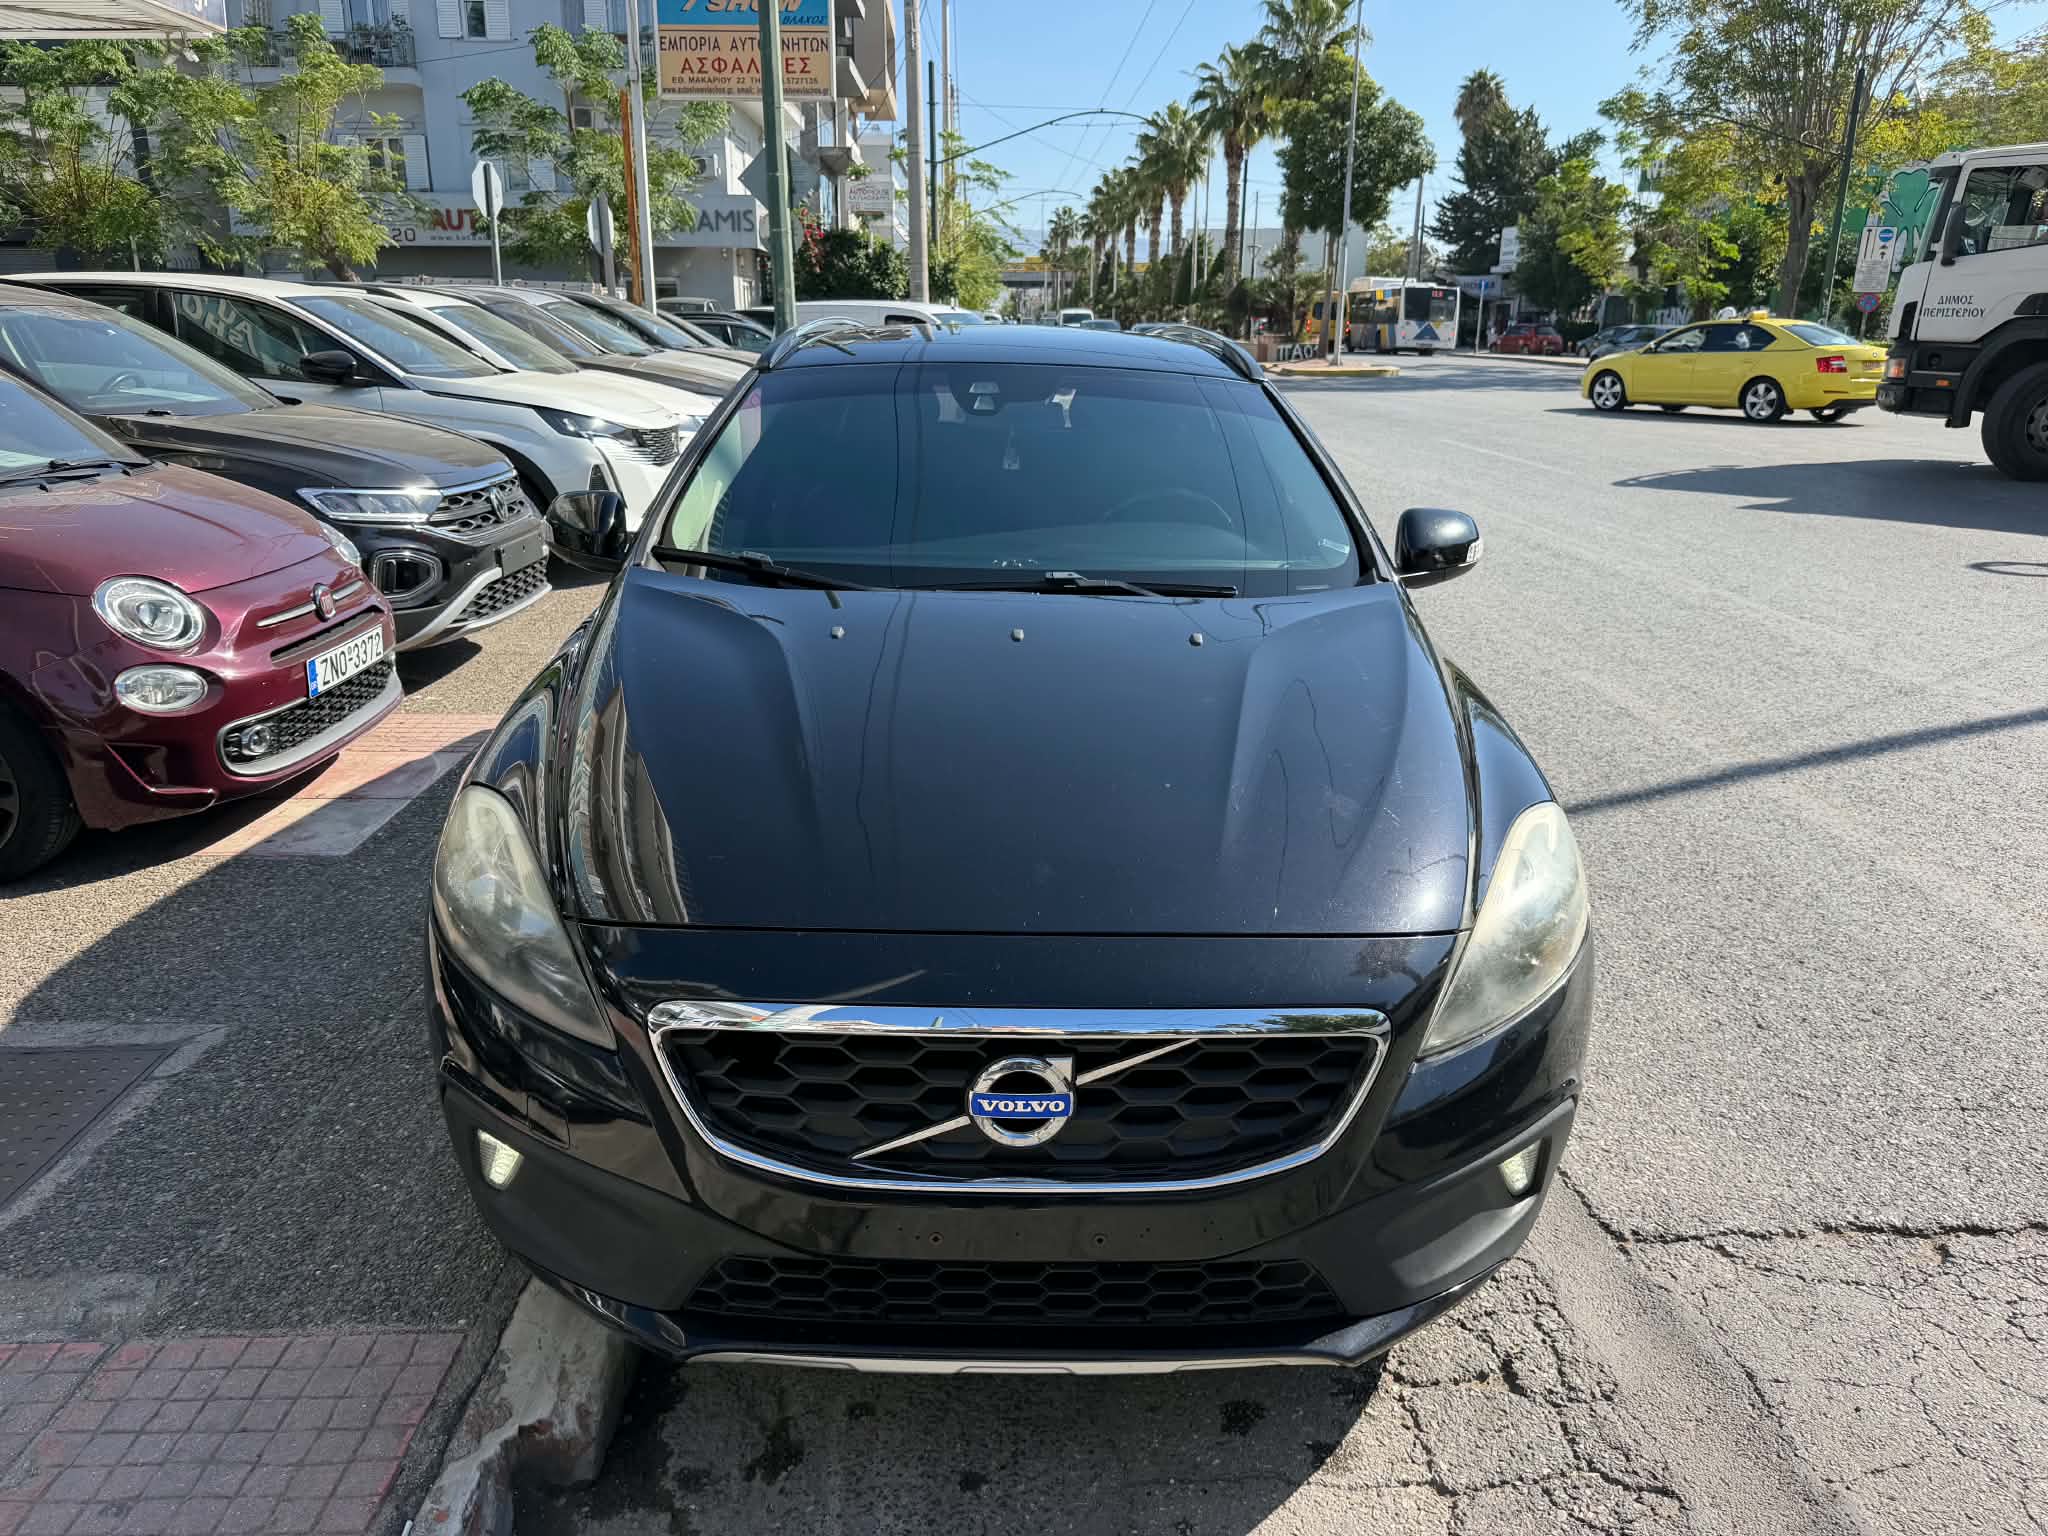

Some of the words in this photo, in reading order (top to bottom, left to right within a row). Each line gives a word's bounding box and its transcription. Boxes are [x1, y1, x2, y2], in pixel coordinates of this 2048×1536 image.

[660, 35, 721, 51] ΕΜΠΟΡΙΑ
[729, 36, 829, 52] ΑΥΤΝΗΤΩΝ
[680, 56, 812, 74] ΑΣΦΑΛΕΣ
[690, 208, 756, 233] AMIS
[1937, 295, 1974, 305] ΔΗΜΟΣ
[1922, 307, 1986, 318] ΠΕΡΙΣΤΕΡΙΟΥ
[320, 631, 382, 687] ZNO-3372
[977, 1099, 1066, 1112] VOLVO
